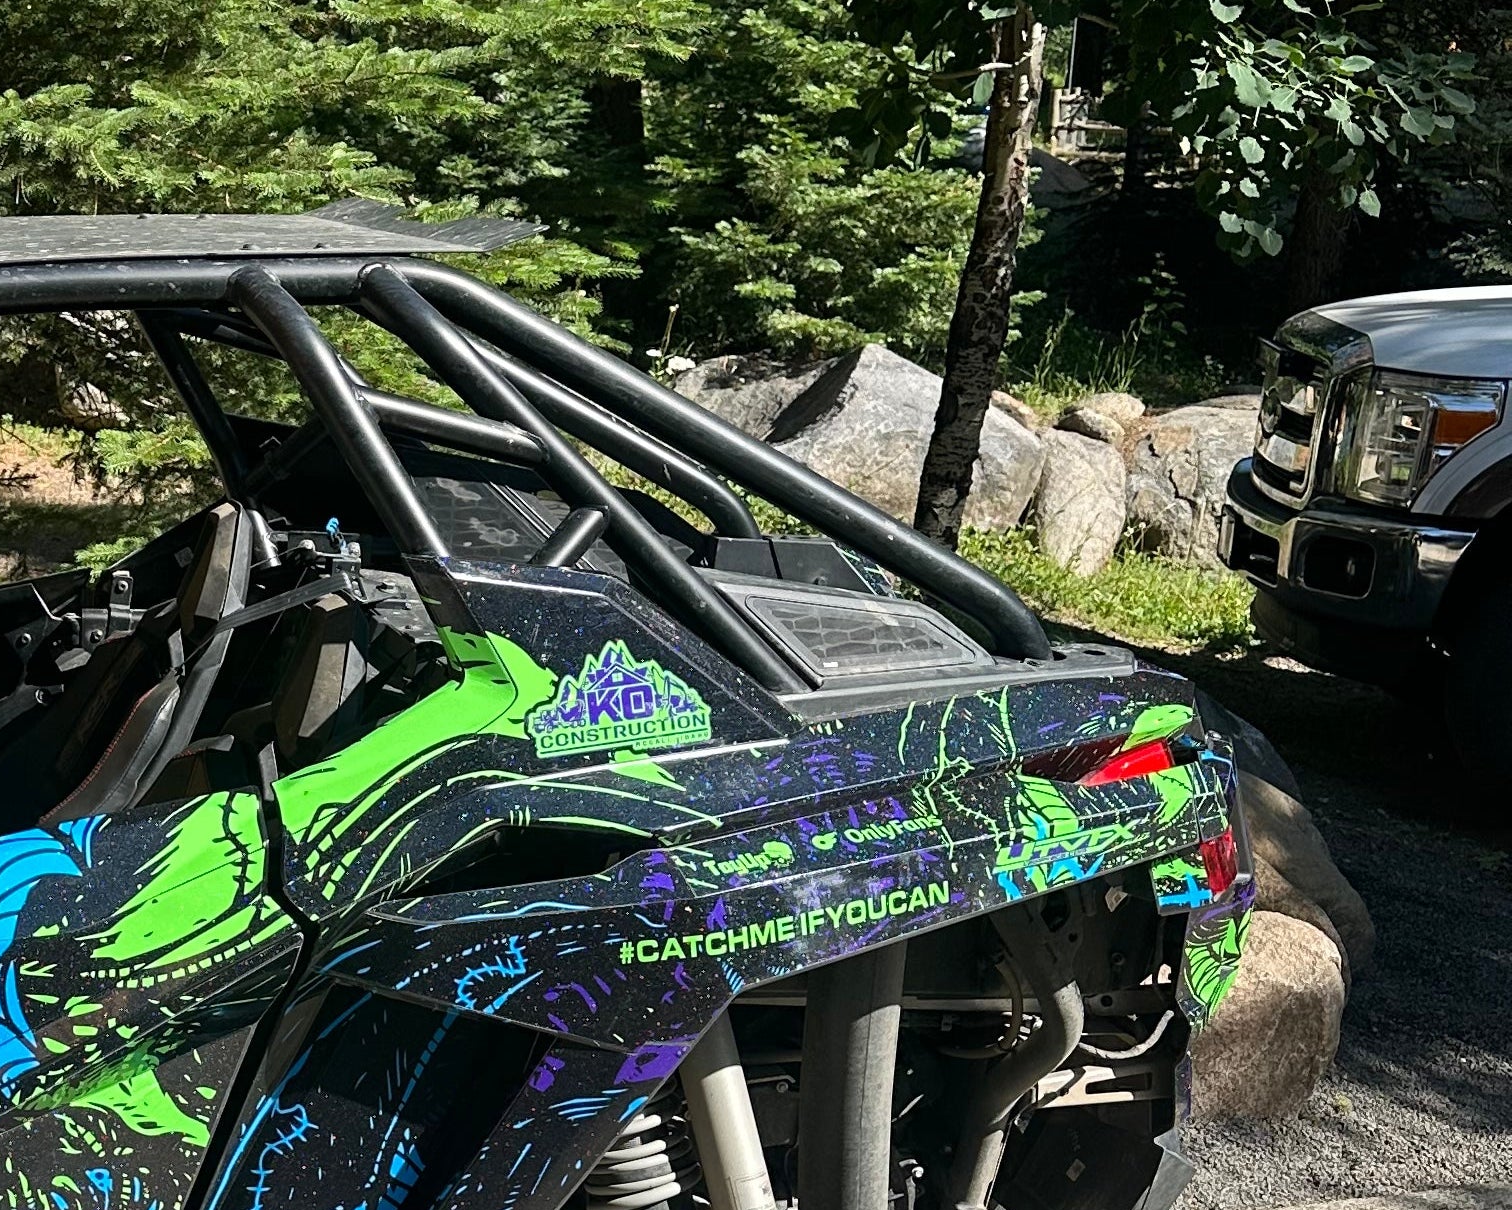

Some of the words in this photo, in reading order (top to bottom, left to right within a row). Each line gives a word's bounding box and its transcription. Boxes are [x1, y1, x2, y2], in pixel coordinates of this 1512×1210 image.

[587, 684, 655, 726] KO
[540, 712, 707, 749] CONSTRUCTION
[844, 813, 943, 843] OnlyFans
